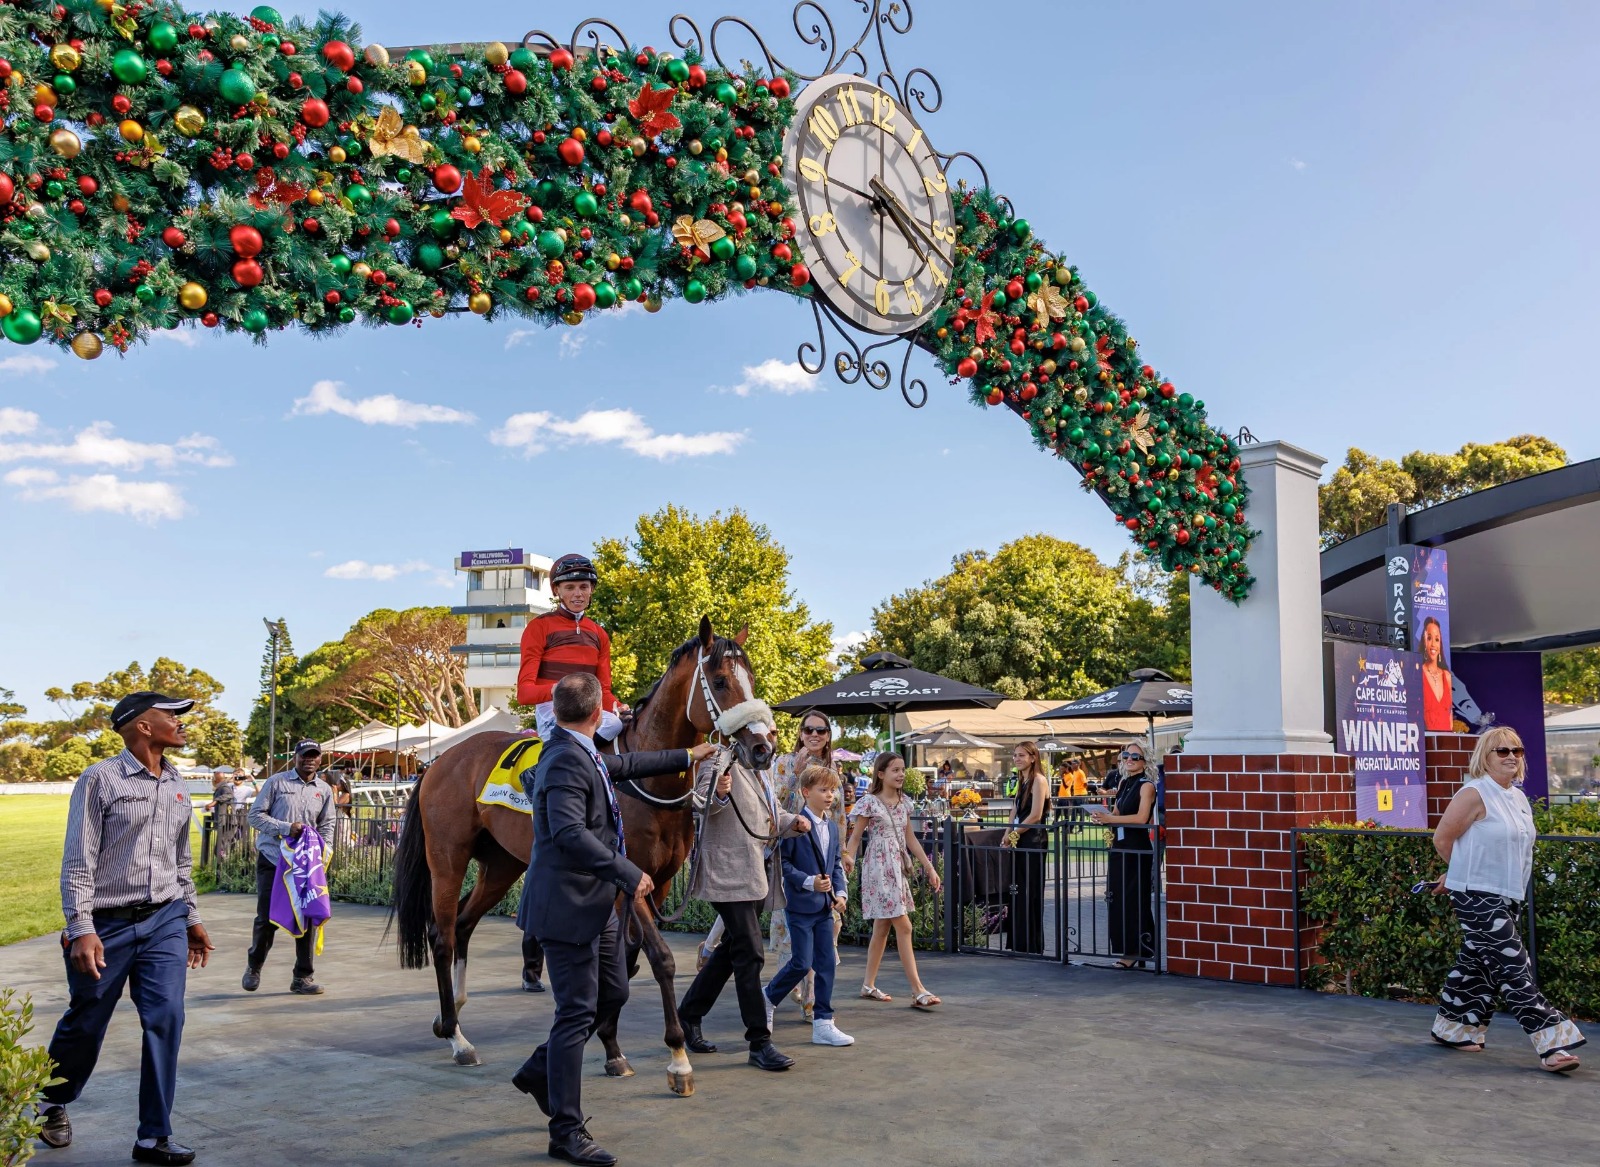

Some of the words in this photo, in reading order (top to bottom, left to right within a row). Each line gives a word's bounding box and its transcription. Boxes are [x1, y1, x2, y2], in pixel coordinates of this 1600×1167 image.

[837, 85, 864, 127] 11
[871, 90, 896, 135] 12
[808, 105, 839, 153] 10
[905, 128, 922, 156] 1
[799, 157, 828, 186] 9
[923, 172, 947, 197] 2
[809, 211, 837, 237] 8
[932, 220, 956, 244] 3
[838, 251, 862, 288] 7
[926, 256, 948, 288] 4
[874, 279, 890, 315] 6
[904, 278, 922, 316] 5
[1413, 596, 1426, 604] CAPE
[884, 688, 942, 696] COAST
[1355, 687, 1375, 701] CAPE
[1376, 688, 1407, 704] GUINEAS
[1341, 719, 1420, 752] WINNER
[1355, 757, 1420, 771] NGRATULATIONS
[1383, 794, 1388, 806] 4
